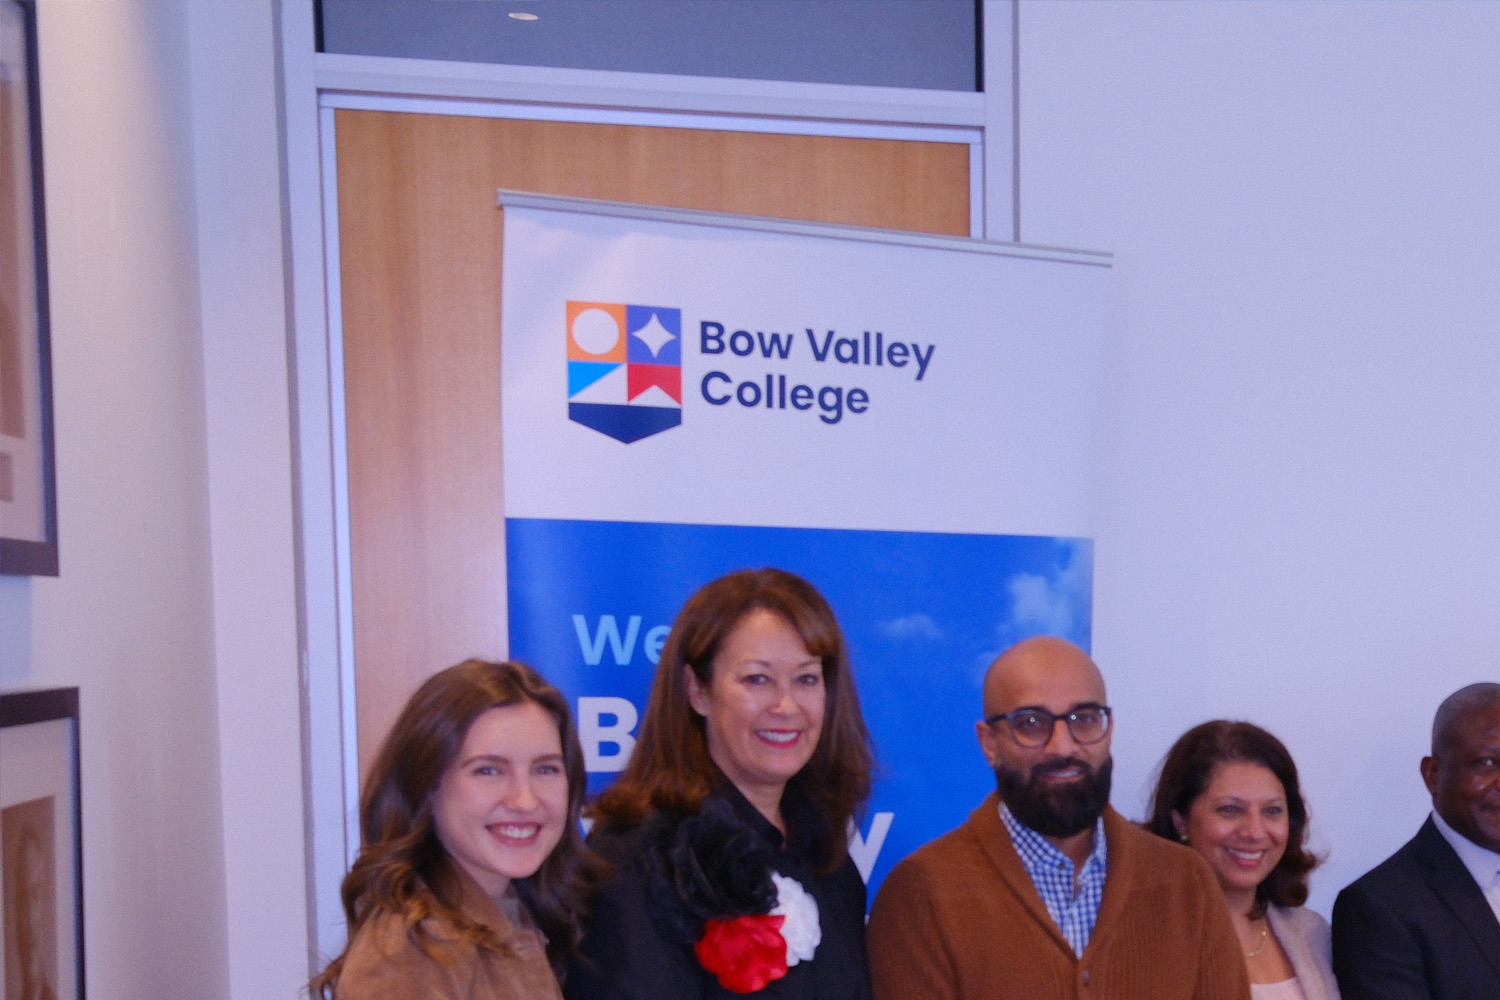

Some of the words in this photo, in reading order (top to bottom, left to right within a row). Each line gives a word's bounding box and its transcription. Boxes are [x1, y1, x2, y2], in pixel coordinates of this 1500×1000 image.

[700, 320, 793, 359] Bow
[806, 328, 936, 381] Valley
[701, 371, 869, 424] College
